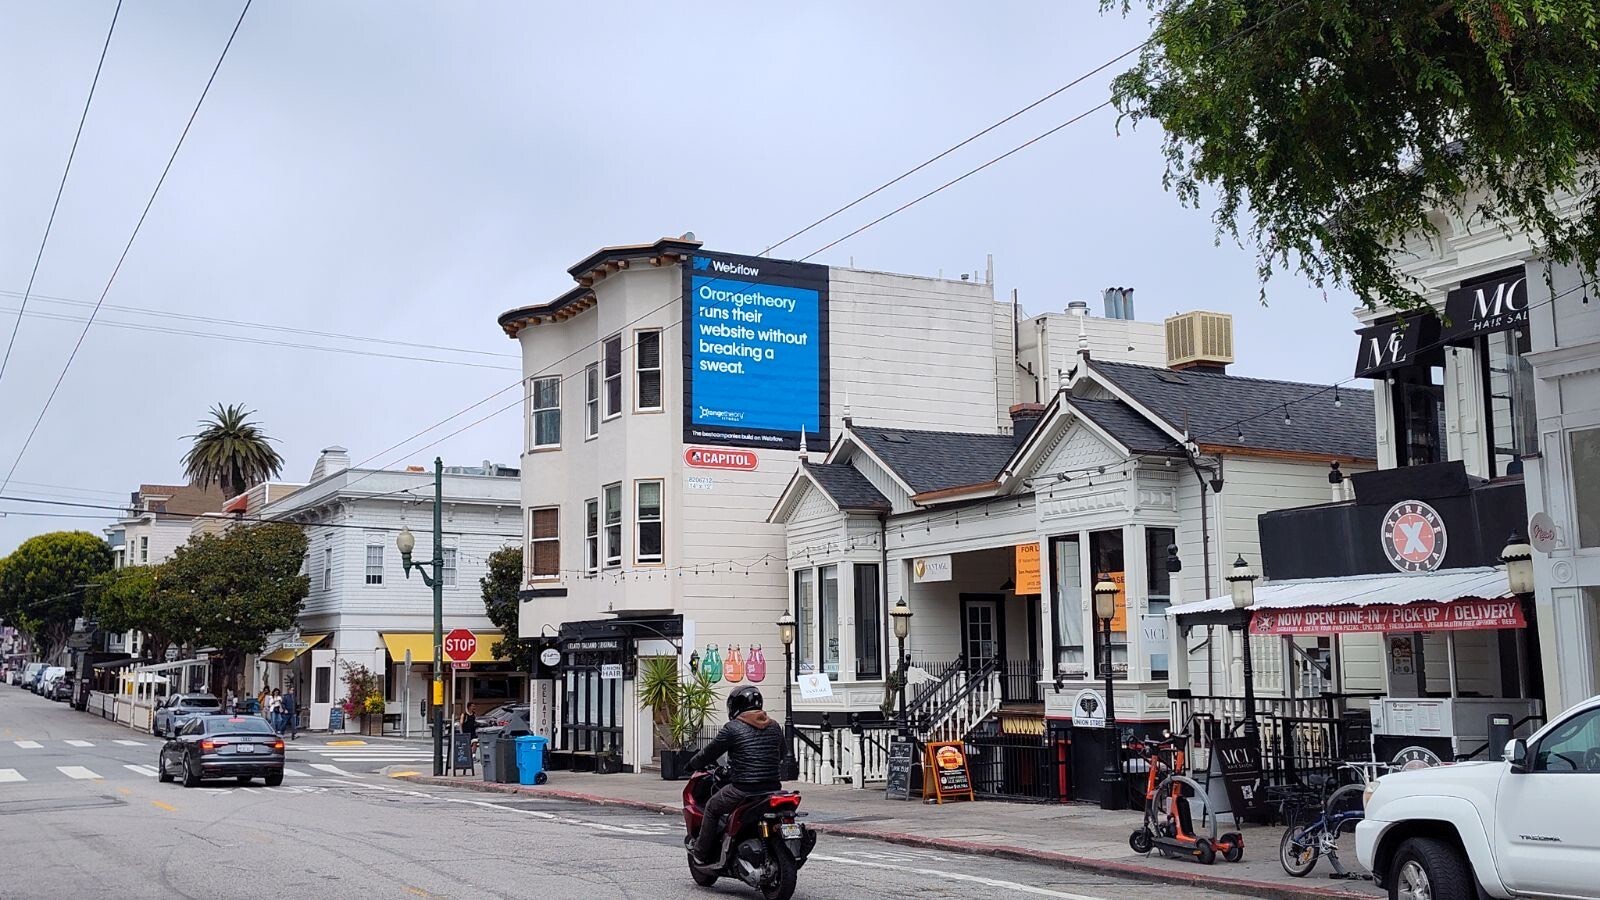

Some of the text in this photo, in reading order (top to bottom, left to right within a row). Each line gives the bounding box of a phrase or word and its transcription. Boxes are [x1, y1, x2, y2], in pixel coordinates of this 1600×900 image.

[712, 260, 759, 276] Webflow
[699, 286, 796, 312] Orangetheory
[699, 306, 762, 323] runs their
[1473, 315, 1502, 331] HAIR
[699, 324, 807, 345] website without
[699, 339, 774, 362] breaking a
[699, 361, 745, 374] sweat.
[703, 452, 751, 465] CAPITOL
[1385, 505, 1441, 539] EXTREME
[1399, 521, 1429, 555] X
[1394, 552, 1440, 571] PIZZA
[1277, 613, 1302, 626] NOW
[1305, 611, 1336, 625] OPEN!
[1339, 609, 1380, 624] DINE-IN
[1393, 607, 1440, 622] PICK-UP
[1454, 603, 1516, 620] DELIVERY
[446, 639, 476, 651] STOP
